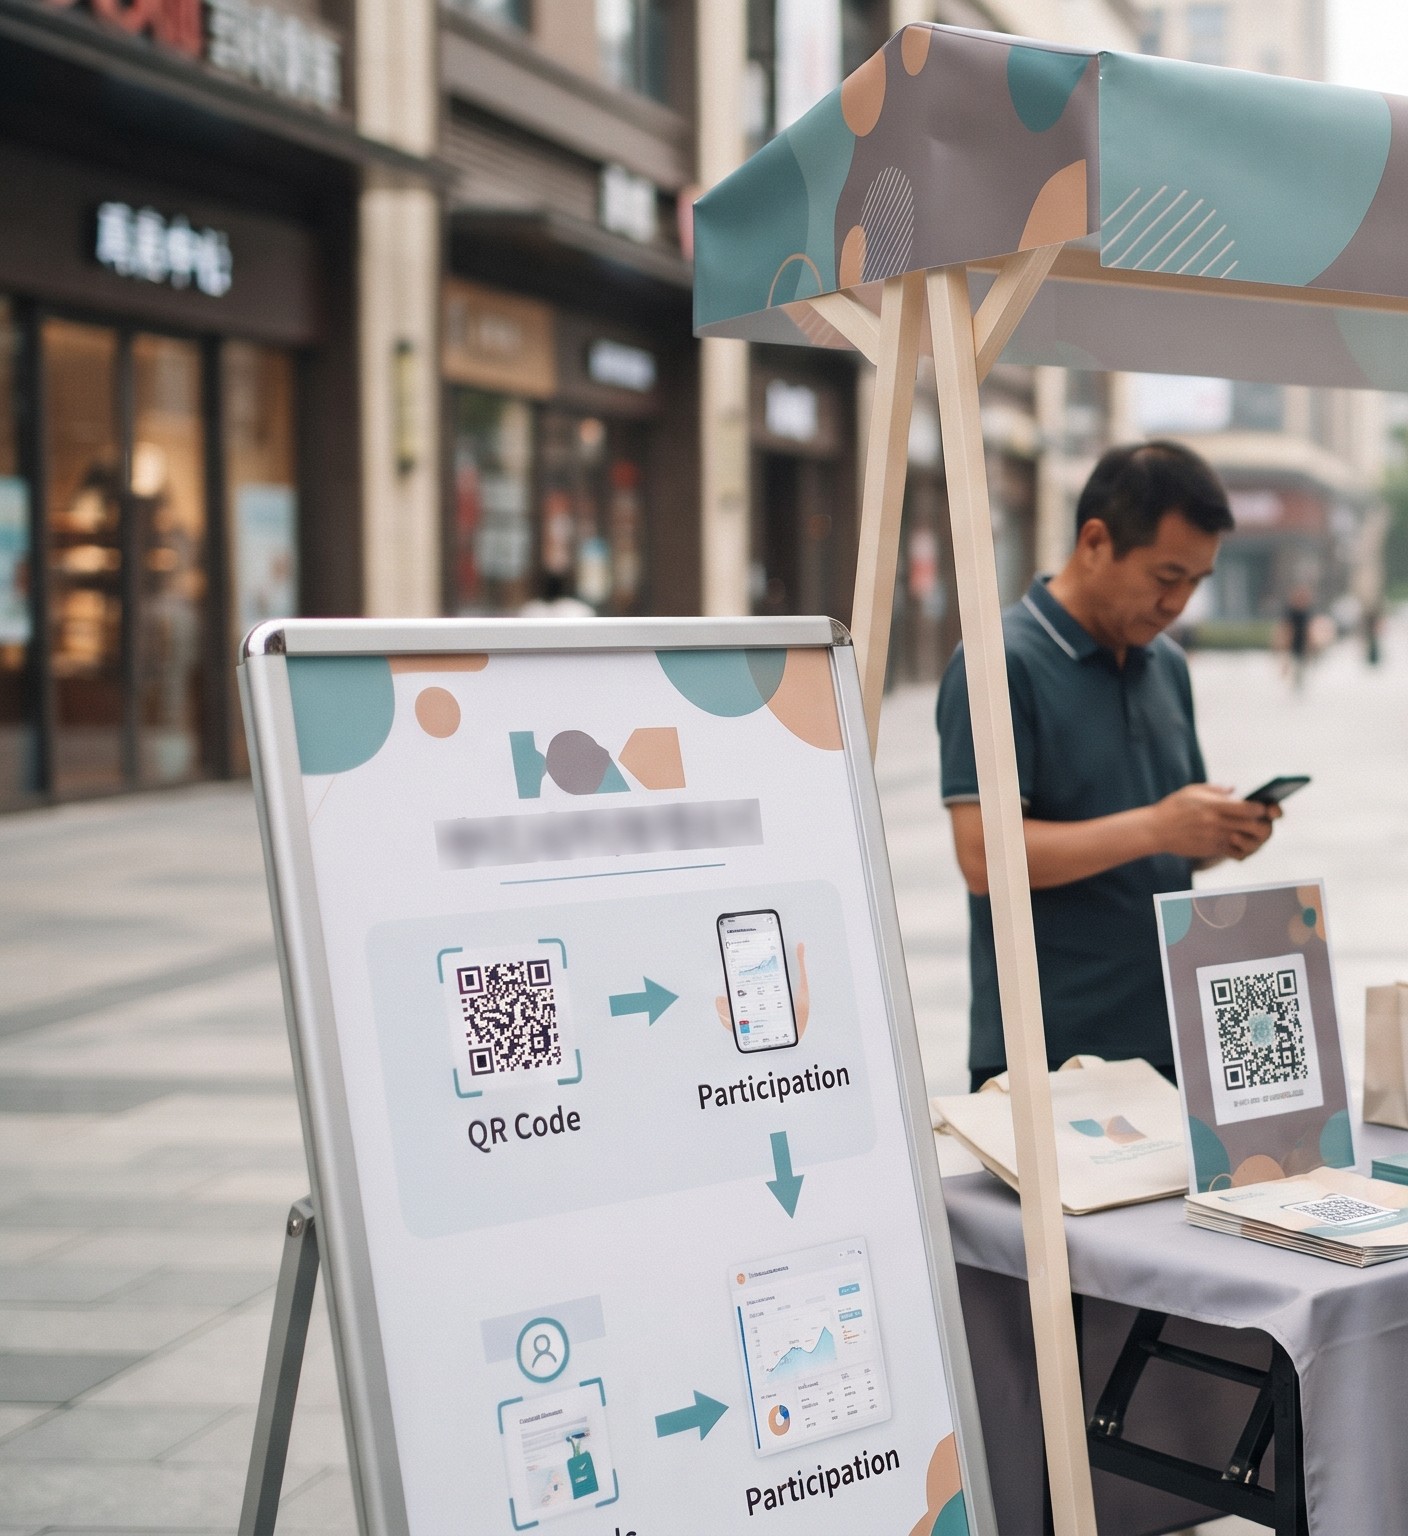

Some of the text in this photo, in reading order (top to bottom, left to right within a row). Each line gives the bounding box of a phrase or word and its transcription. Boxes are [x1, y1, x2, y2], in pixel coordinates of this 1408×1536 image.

[697, 1064, 851, 1110] Participation
[468, 1105, 582, 1154] QR Code
[745, 1449, 901, 1517] Participation
